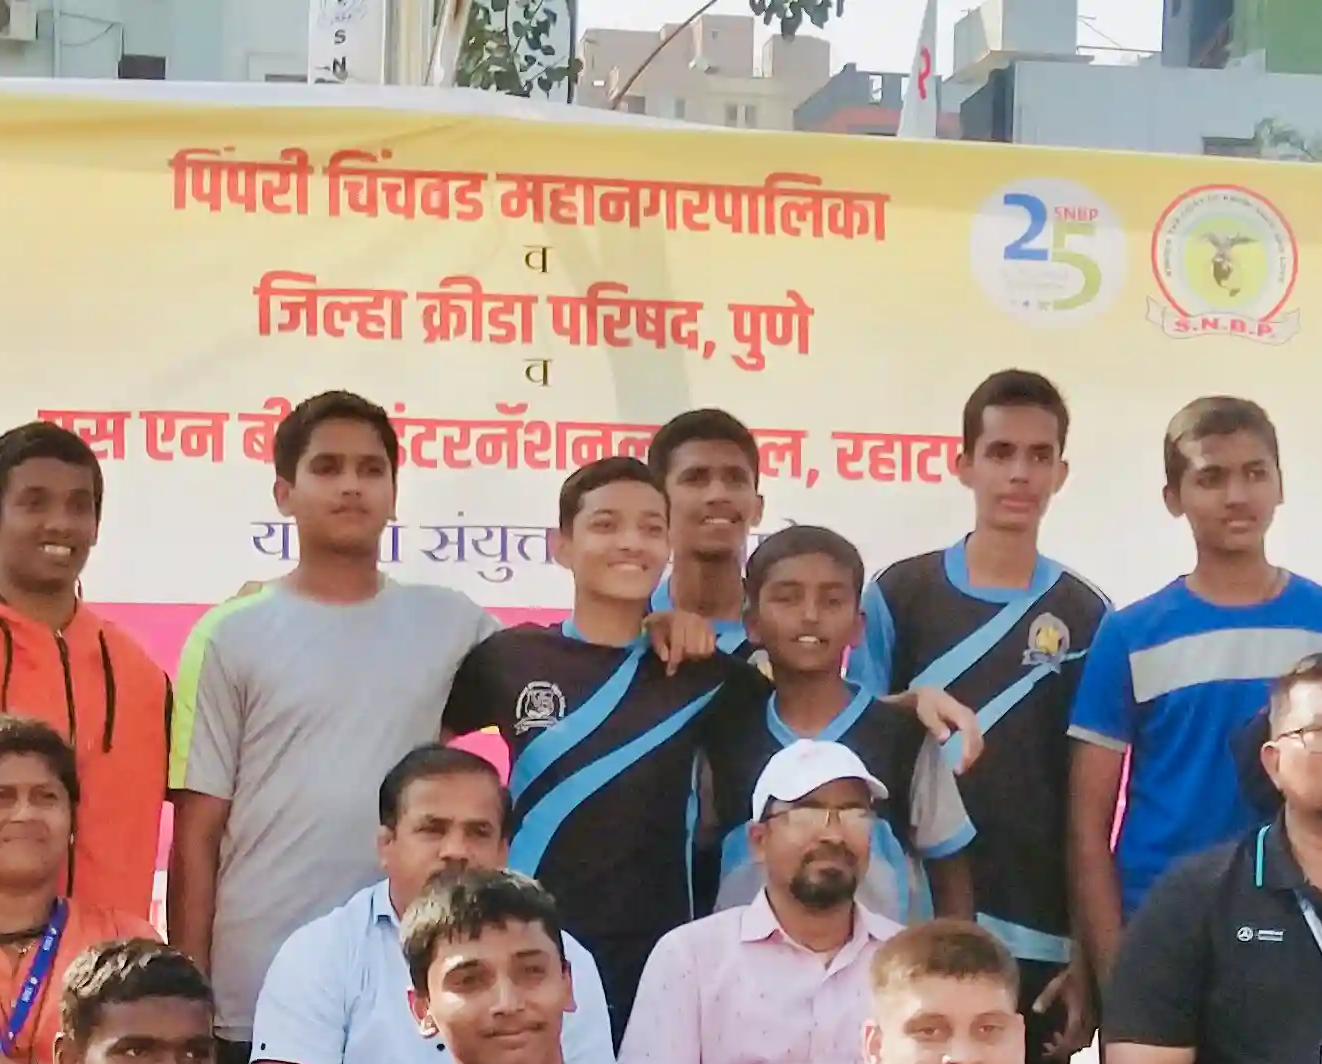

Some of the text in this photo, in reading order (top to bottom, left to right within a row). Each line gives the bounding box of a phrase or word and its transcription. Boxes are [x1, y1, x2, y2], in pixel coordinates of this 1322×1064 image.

[168, 146, 891, 242] पिंपरी चिंचवड महानगरपालिका
[523, 244, 553, 273] व
[1003, 193, 1102, 311] 25
[253, 270, 815, 372] जिल्हा क्रीडा परिषद, पुणे
[523, 358, 553, 387] व
[139, 411, 230, 463] एन
